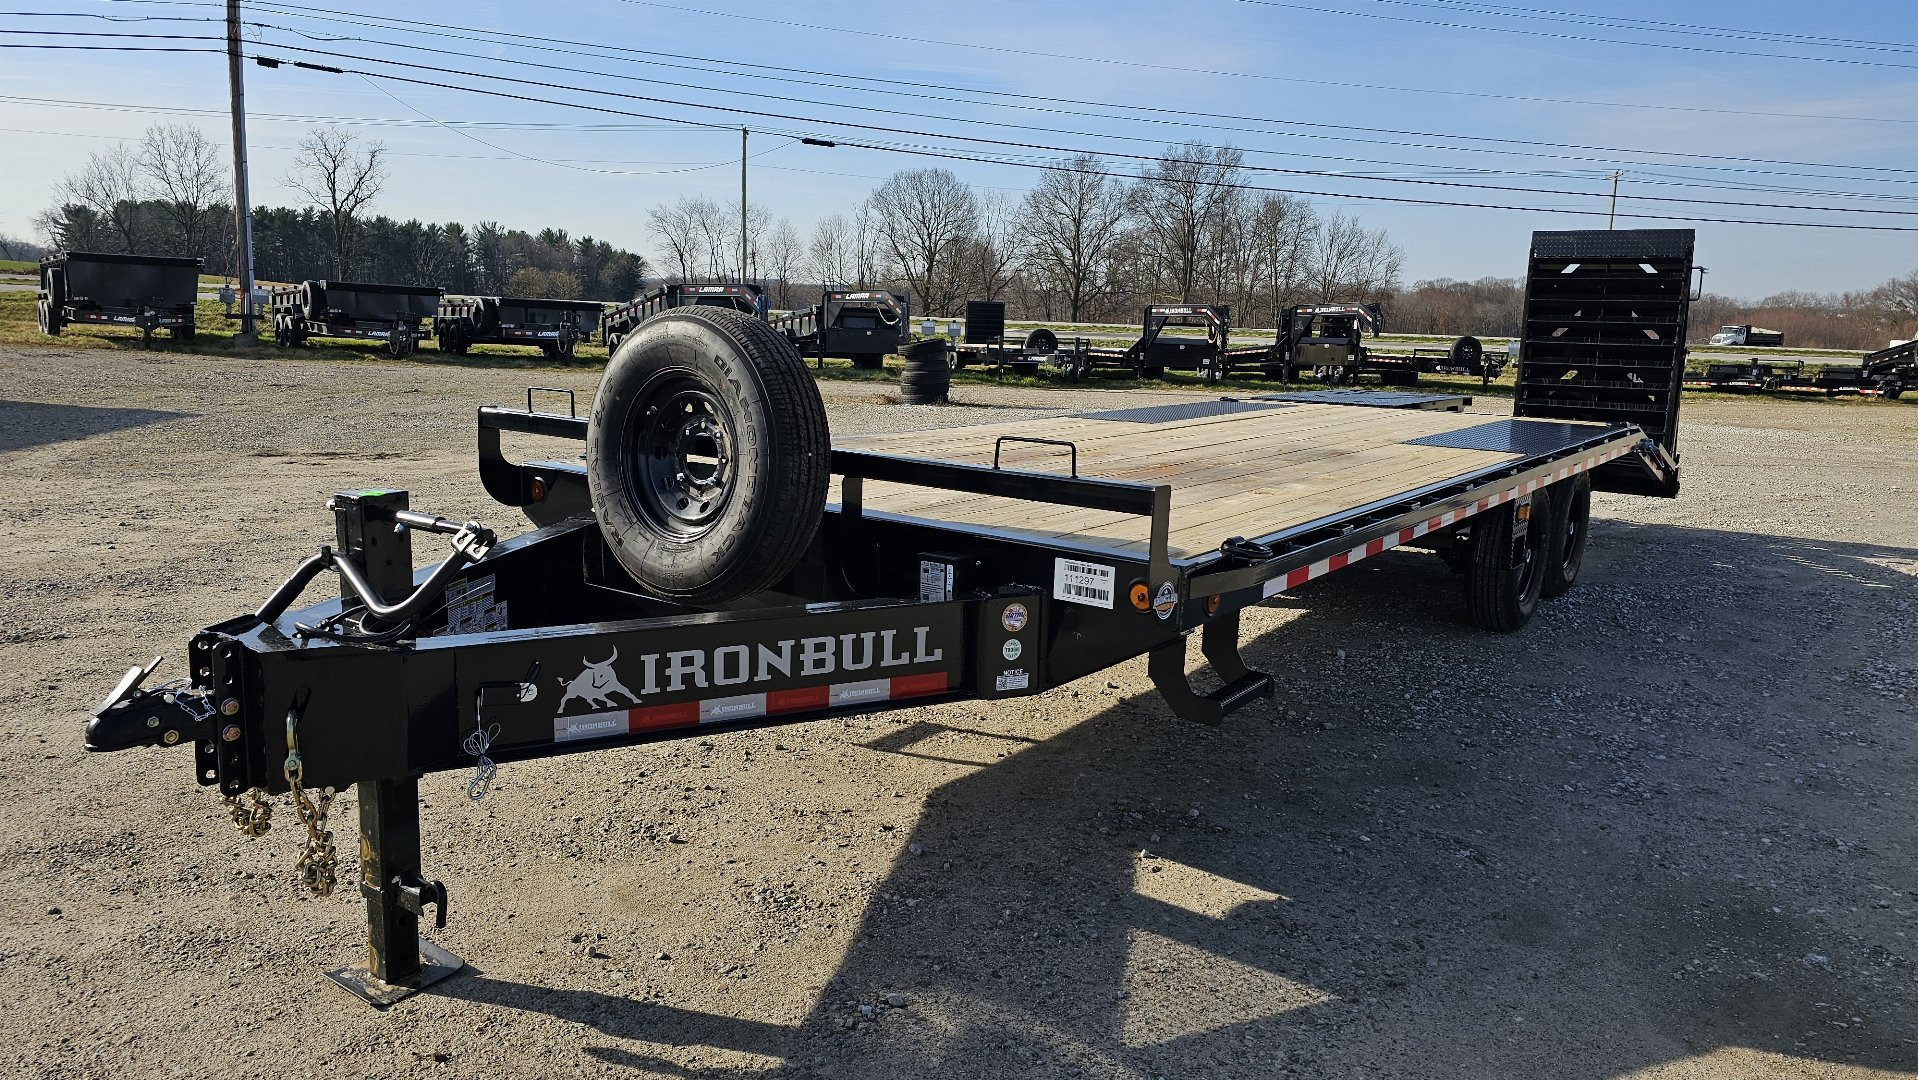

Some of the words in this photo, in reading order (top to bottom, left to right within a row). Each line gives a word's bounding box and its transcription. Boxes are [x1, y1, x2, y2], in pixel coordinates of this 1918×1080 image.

[845, 292, 871, 300] LAMAR
[1064, 573, 1095, 586] 111297
[640, 626, 943, 695] IRONBULL
[1003, 668, 1024, 676] NOTICE
[849, 687, 881, 697] IRONBULL
[721, 701, 757, 713] IRONBULL
[578, 718, 617, 732] IRONBULL
